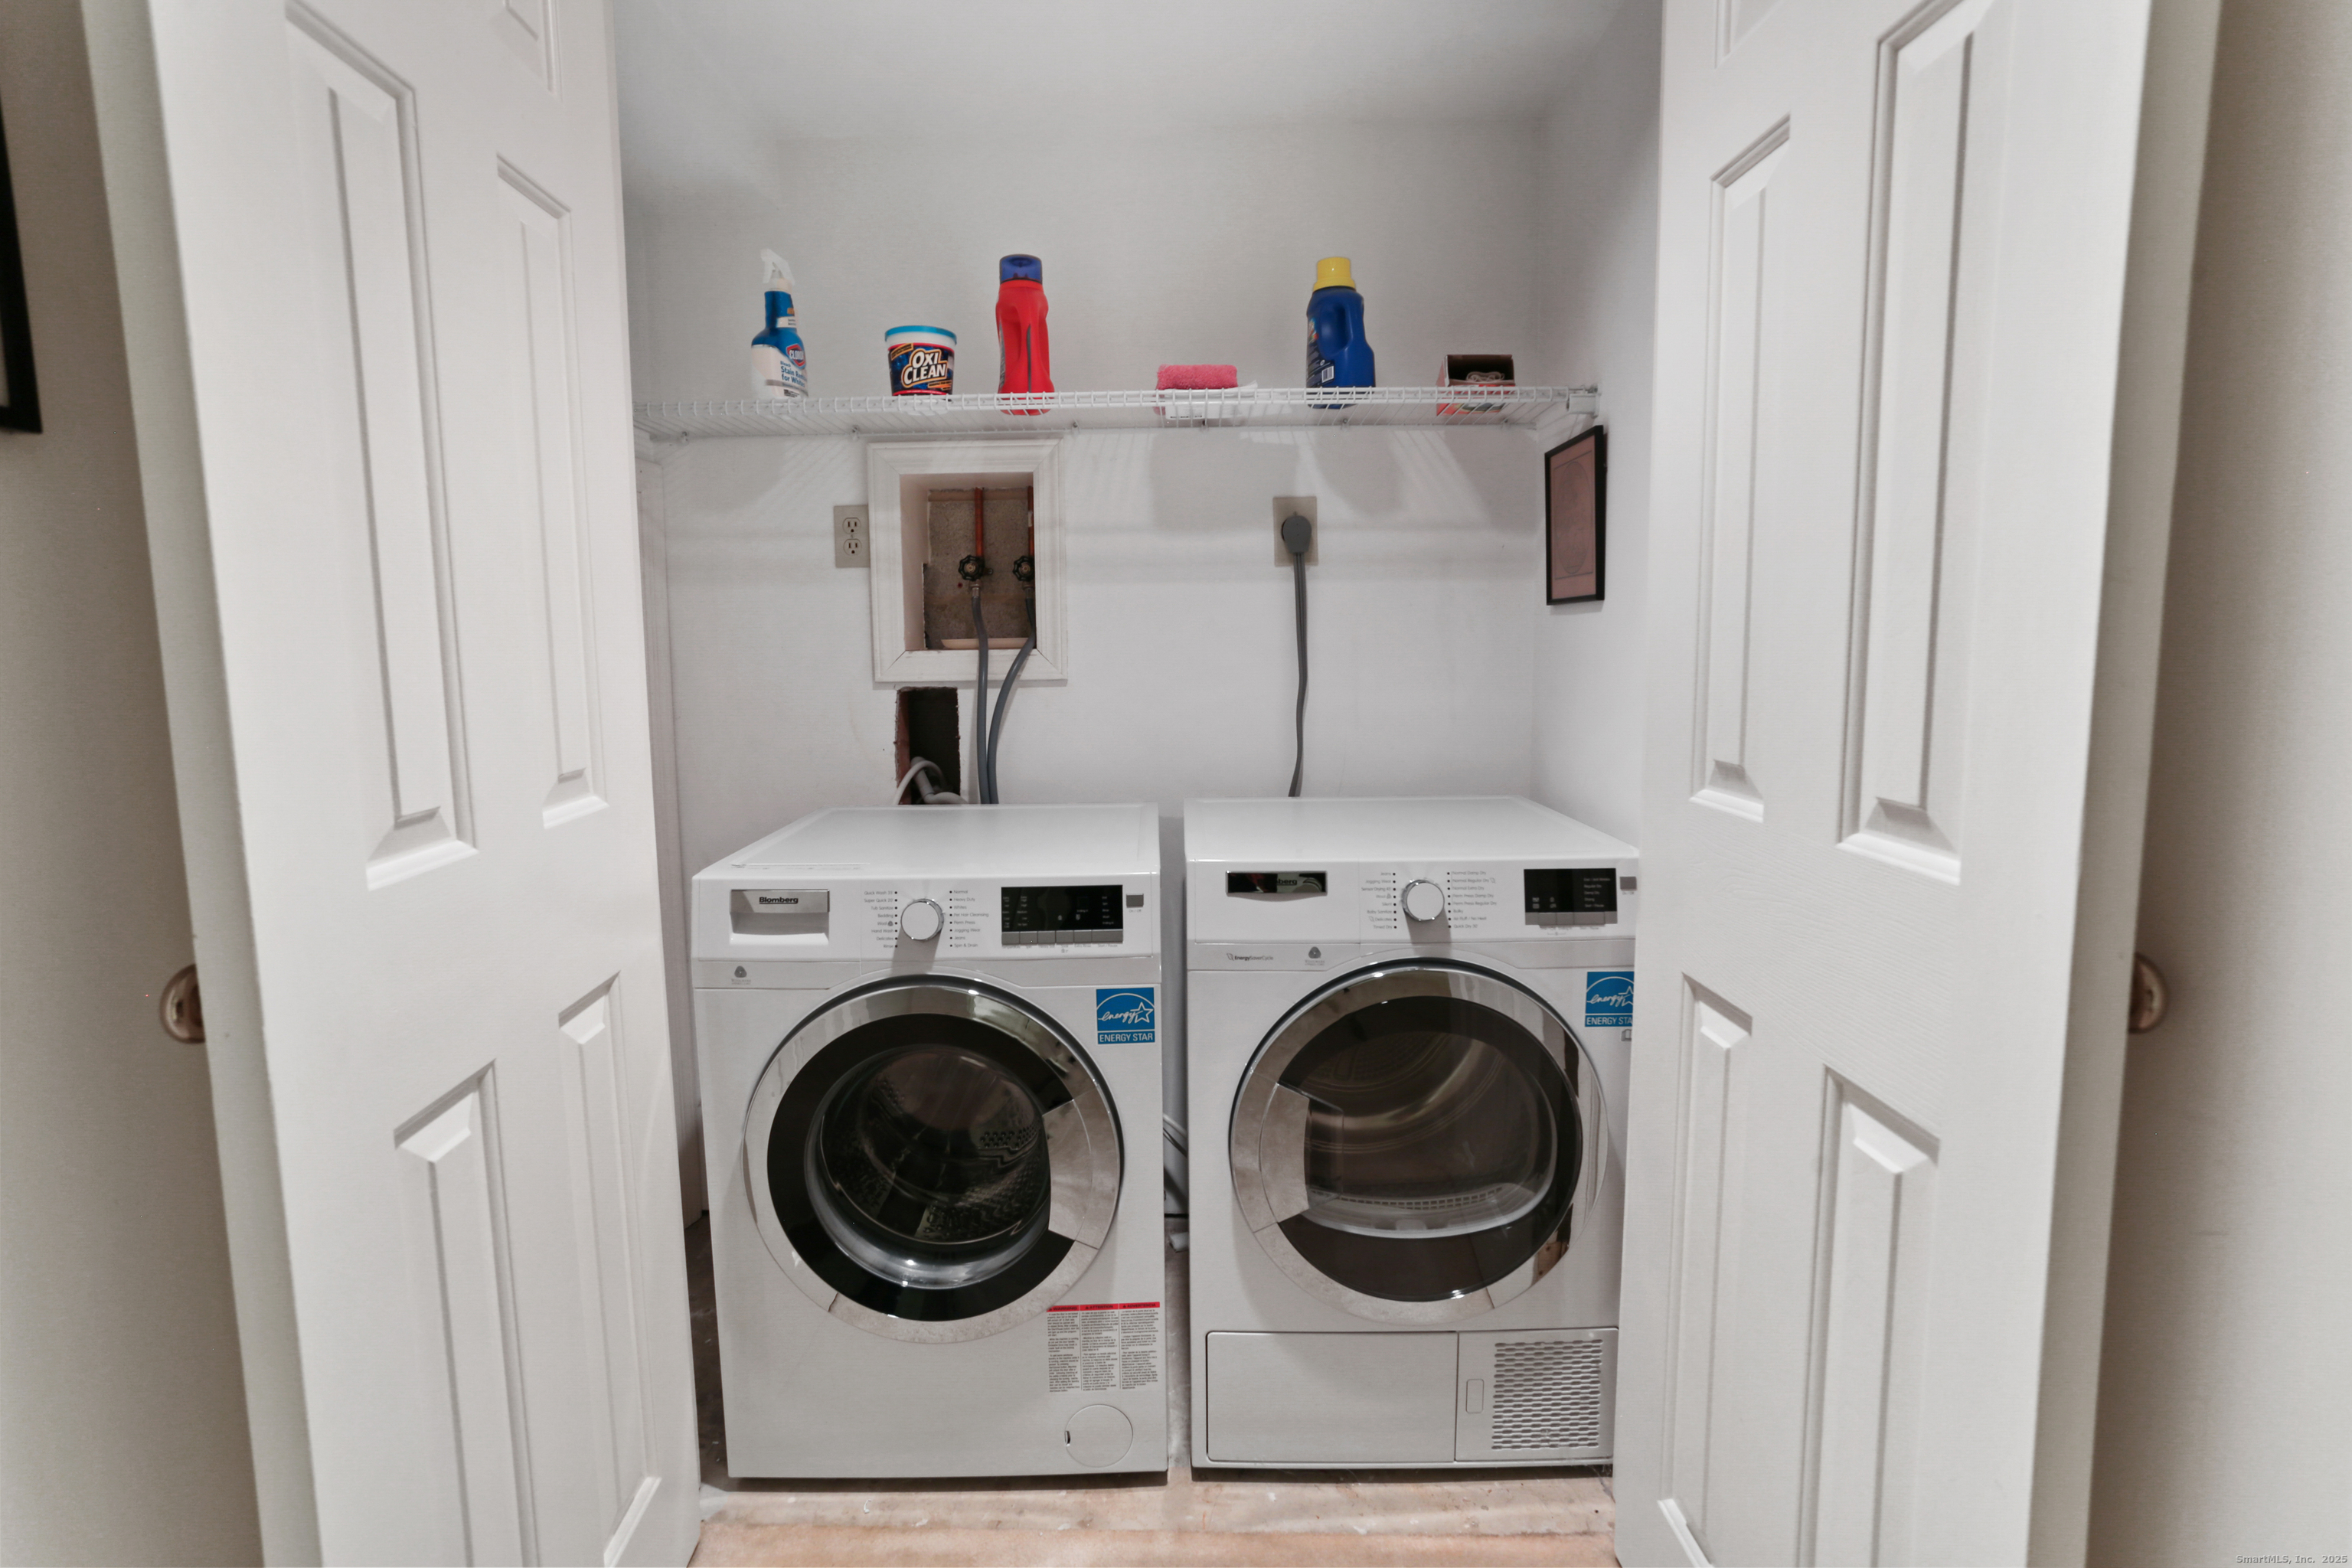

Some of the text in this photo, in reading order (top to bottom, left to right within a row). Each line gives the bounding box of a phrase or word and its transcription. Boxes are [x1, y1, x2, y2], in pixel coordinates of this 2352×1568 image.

[781, 366, 794, 376] Stain
[904, 364, 946, 384] CLEAN
[1098, 1011, 1138, 1024] energy
[1586, 1017, 1617, 1025] ENERGY
[1099, 1033, 1153, 1042] ENERGY STAR
